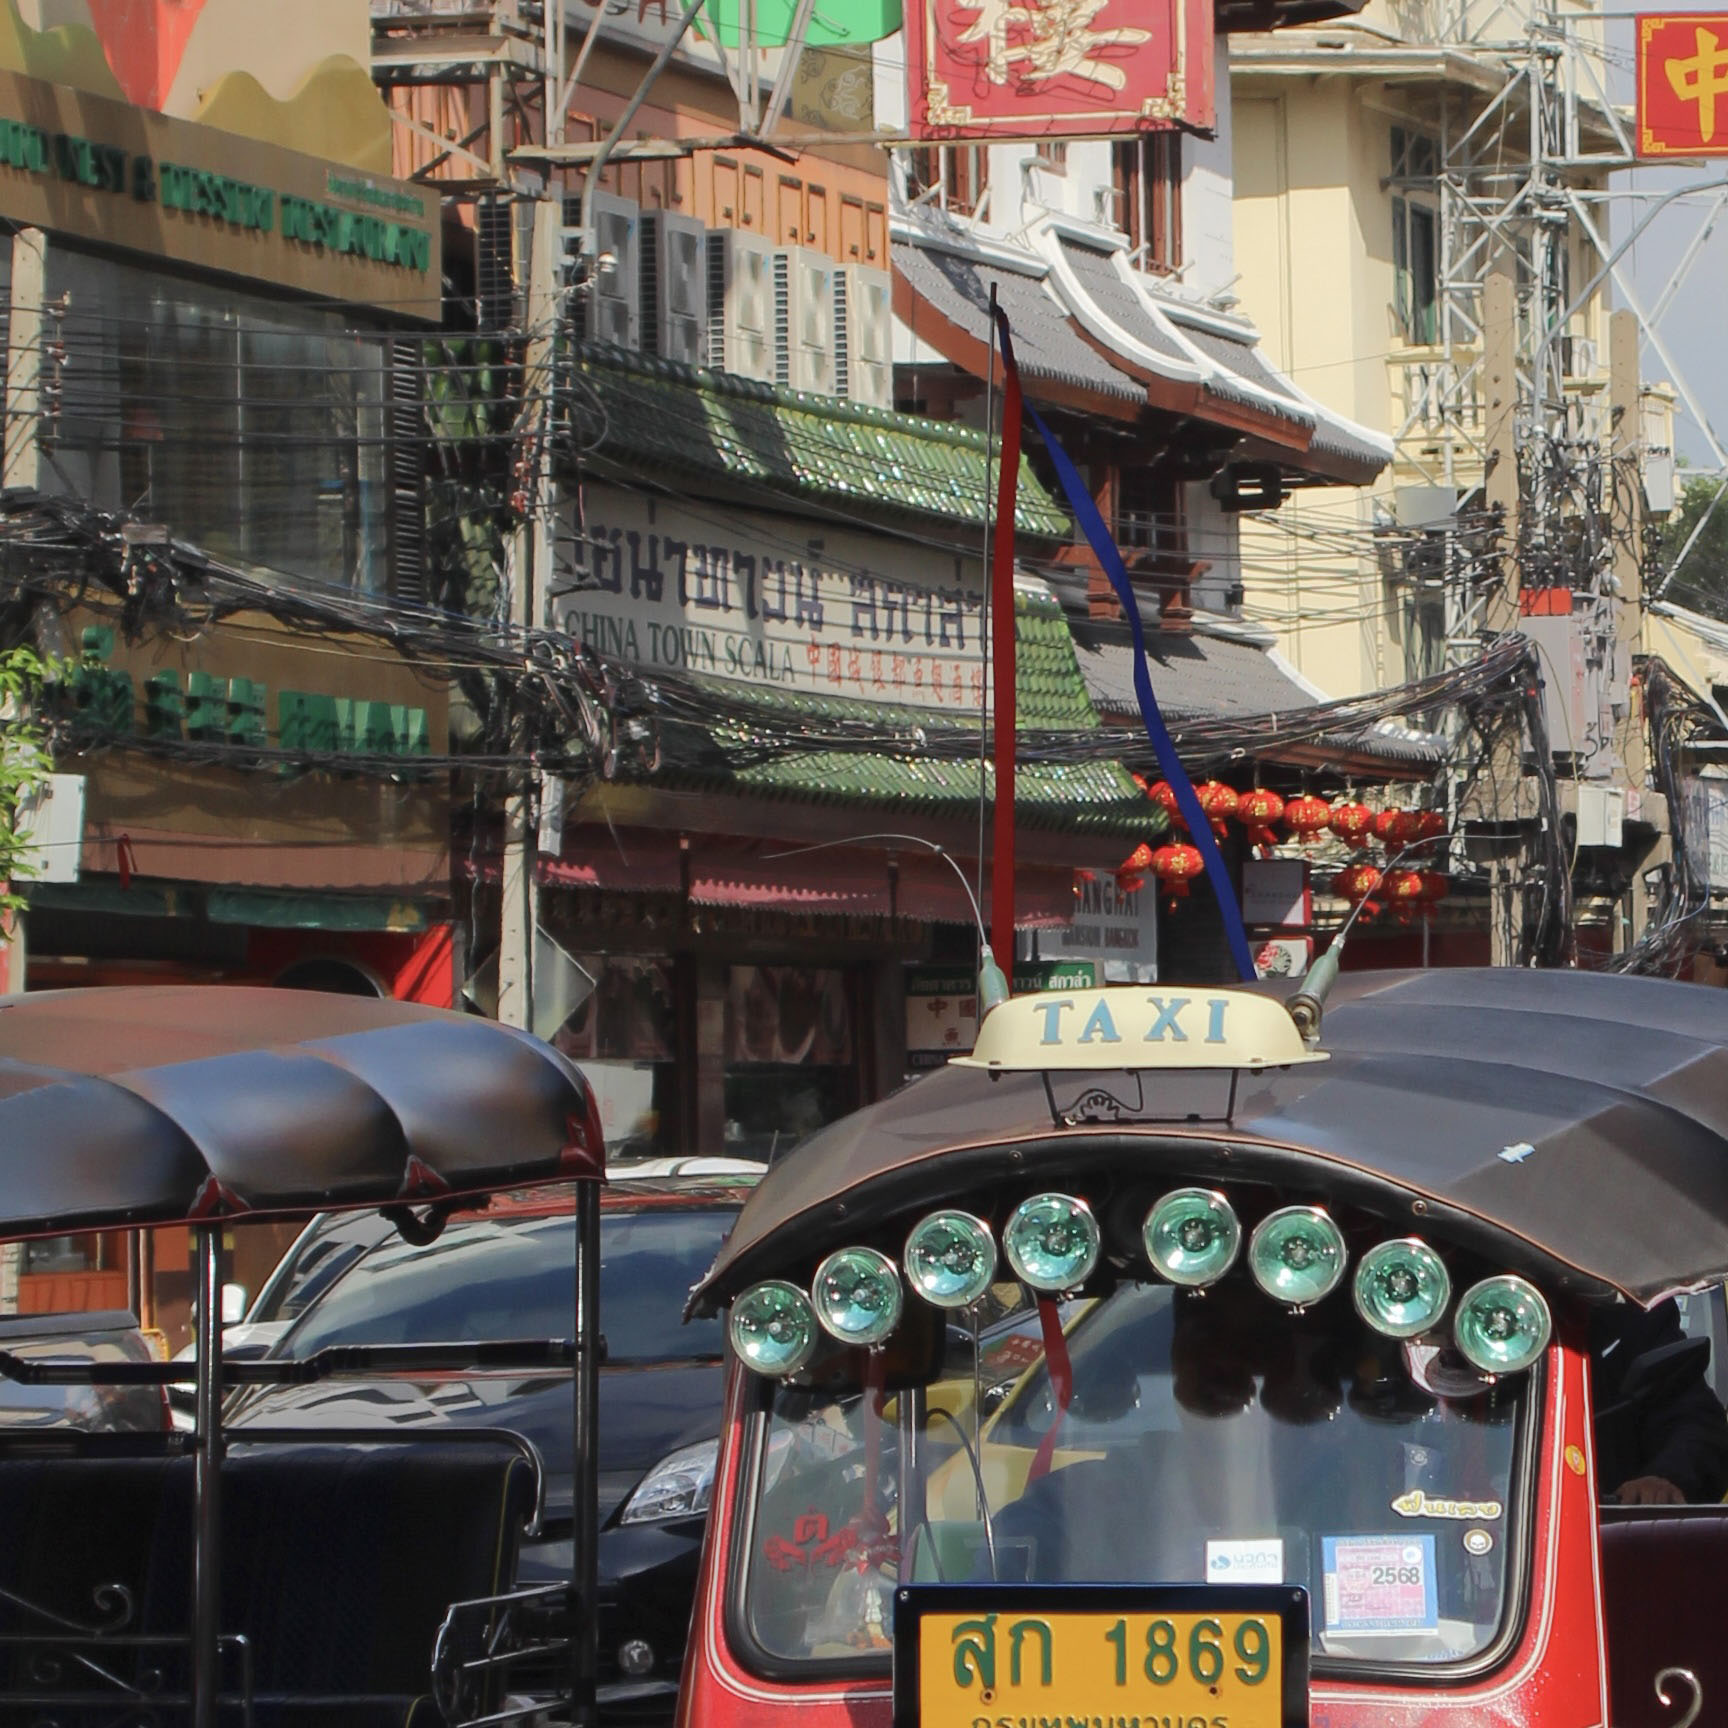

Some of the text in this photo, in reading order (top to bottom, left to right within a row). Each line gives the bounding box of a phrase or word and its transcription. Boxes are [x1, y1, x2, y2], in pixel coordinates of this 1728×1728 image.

[564, 609, 796, 685] CHINA TOWN SCALA
[1032, 997, 1230, 1046] TAXI
[1372, 1566, 1421, 1585] 2568
[1106, 1617, 1272, 1687] 1869
